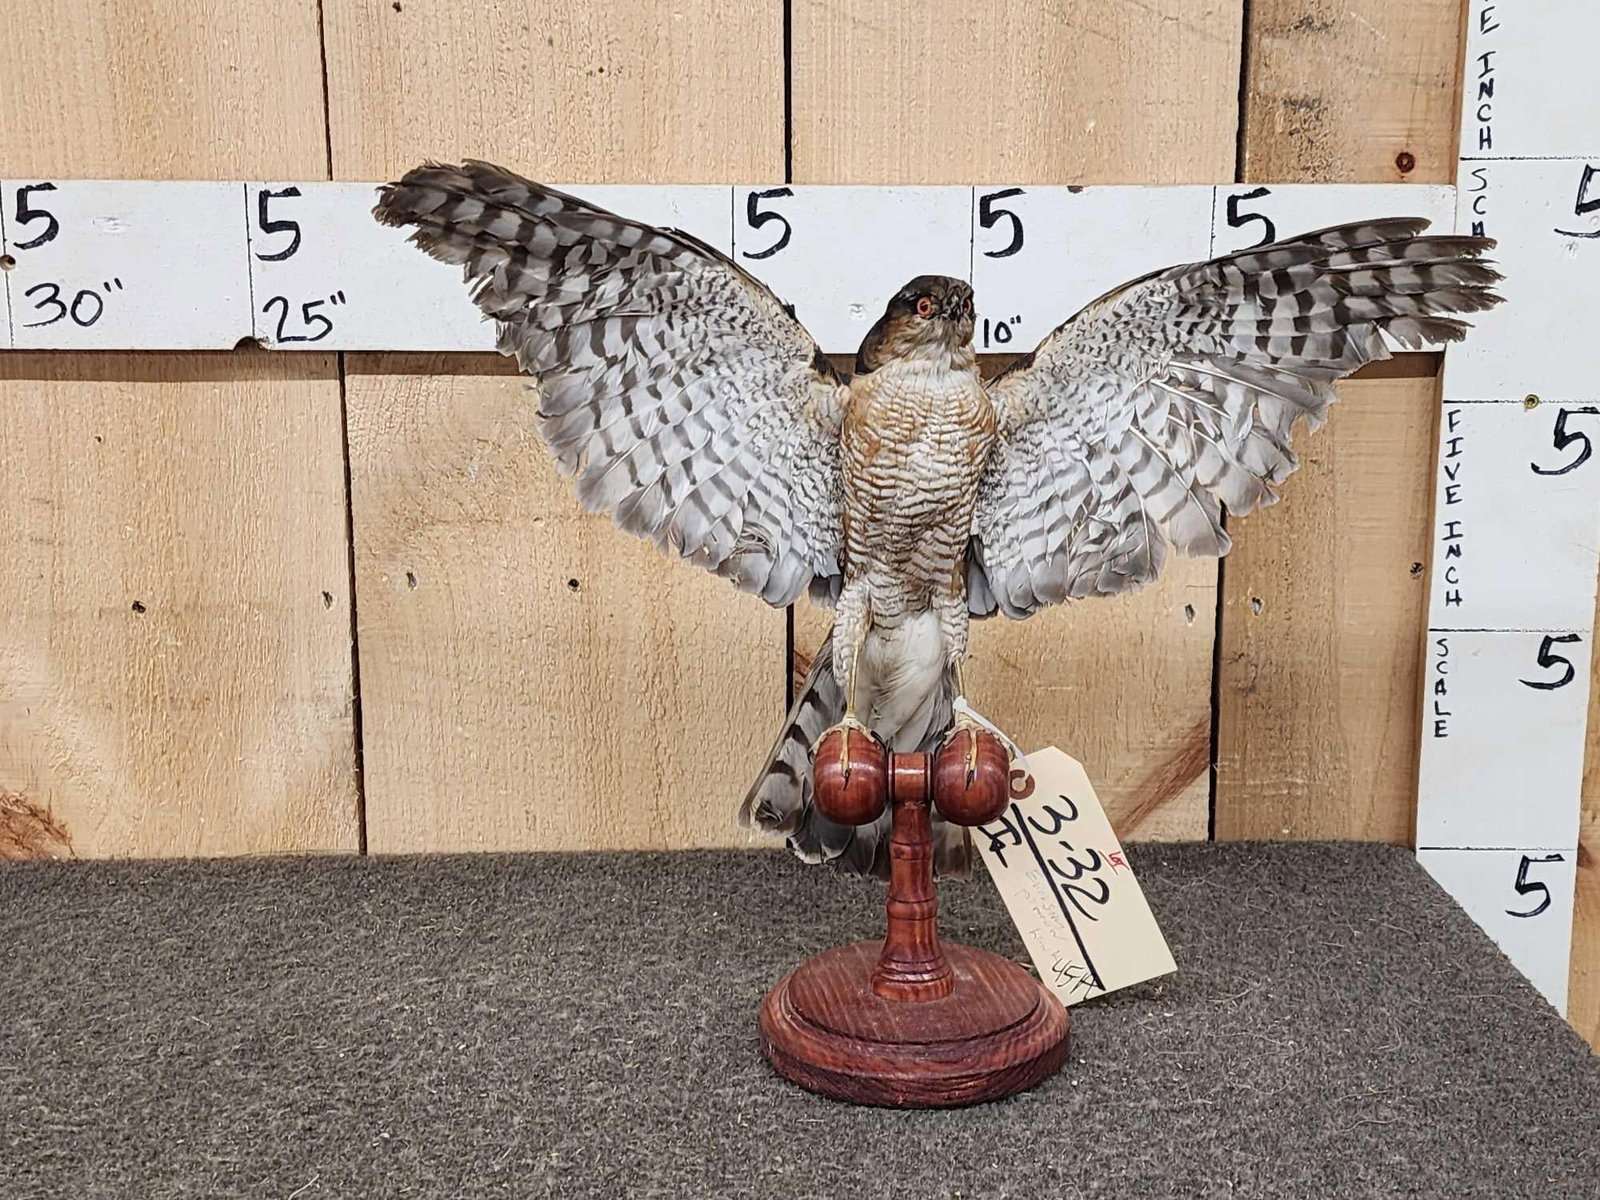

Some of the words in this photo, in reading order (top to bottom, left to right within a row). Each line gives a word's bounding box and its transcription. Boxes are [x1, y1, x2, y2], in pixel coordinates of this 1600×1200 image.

[1477, 50, 1496, 151] INCH
[13, 181, 59, 251] 5
[255, 186, 302, 262] 5
[743, 186, 794, 260] 5
[979, 187, 1026, 259] 5
[1227, 186, 1276, 253] 5
[1553, 163, 1600, 239] 5
[22, 277, 123, 328] 30"
[262, 290, 346, 343] 25"
[983, 315, 1021, 348] 10"
[1444, 409, 1464, 505] FIVE
[1530, 406, 1600, 476] 5
[1442, 520, 1464, 607] INCH
[1434, 638, 1452, 738] SCALE
[1519, 633, 1582, 691] 5
[1027, 794, 1110, 922] 3-32
[1505, 853, 1565, 919] 5
